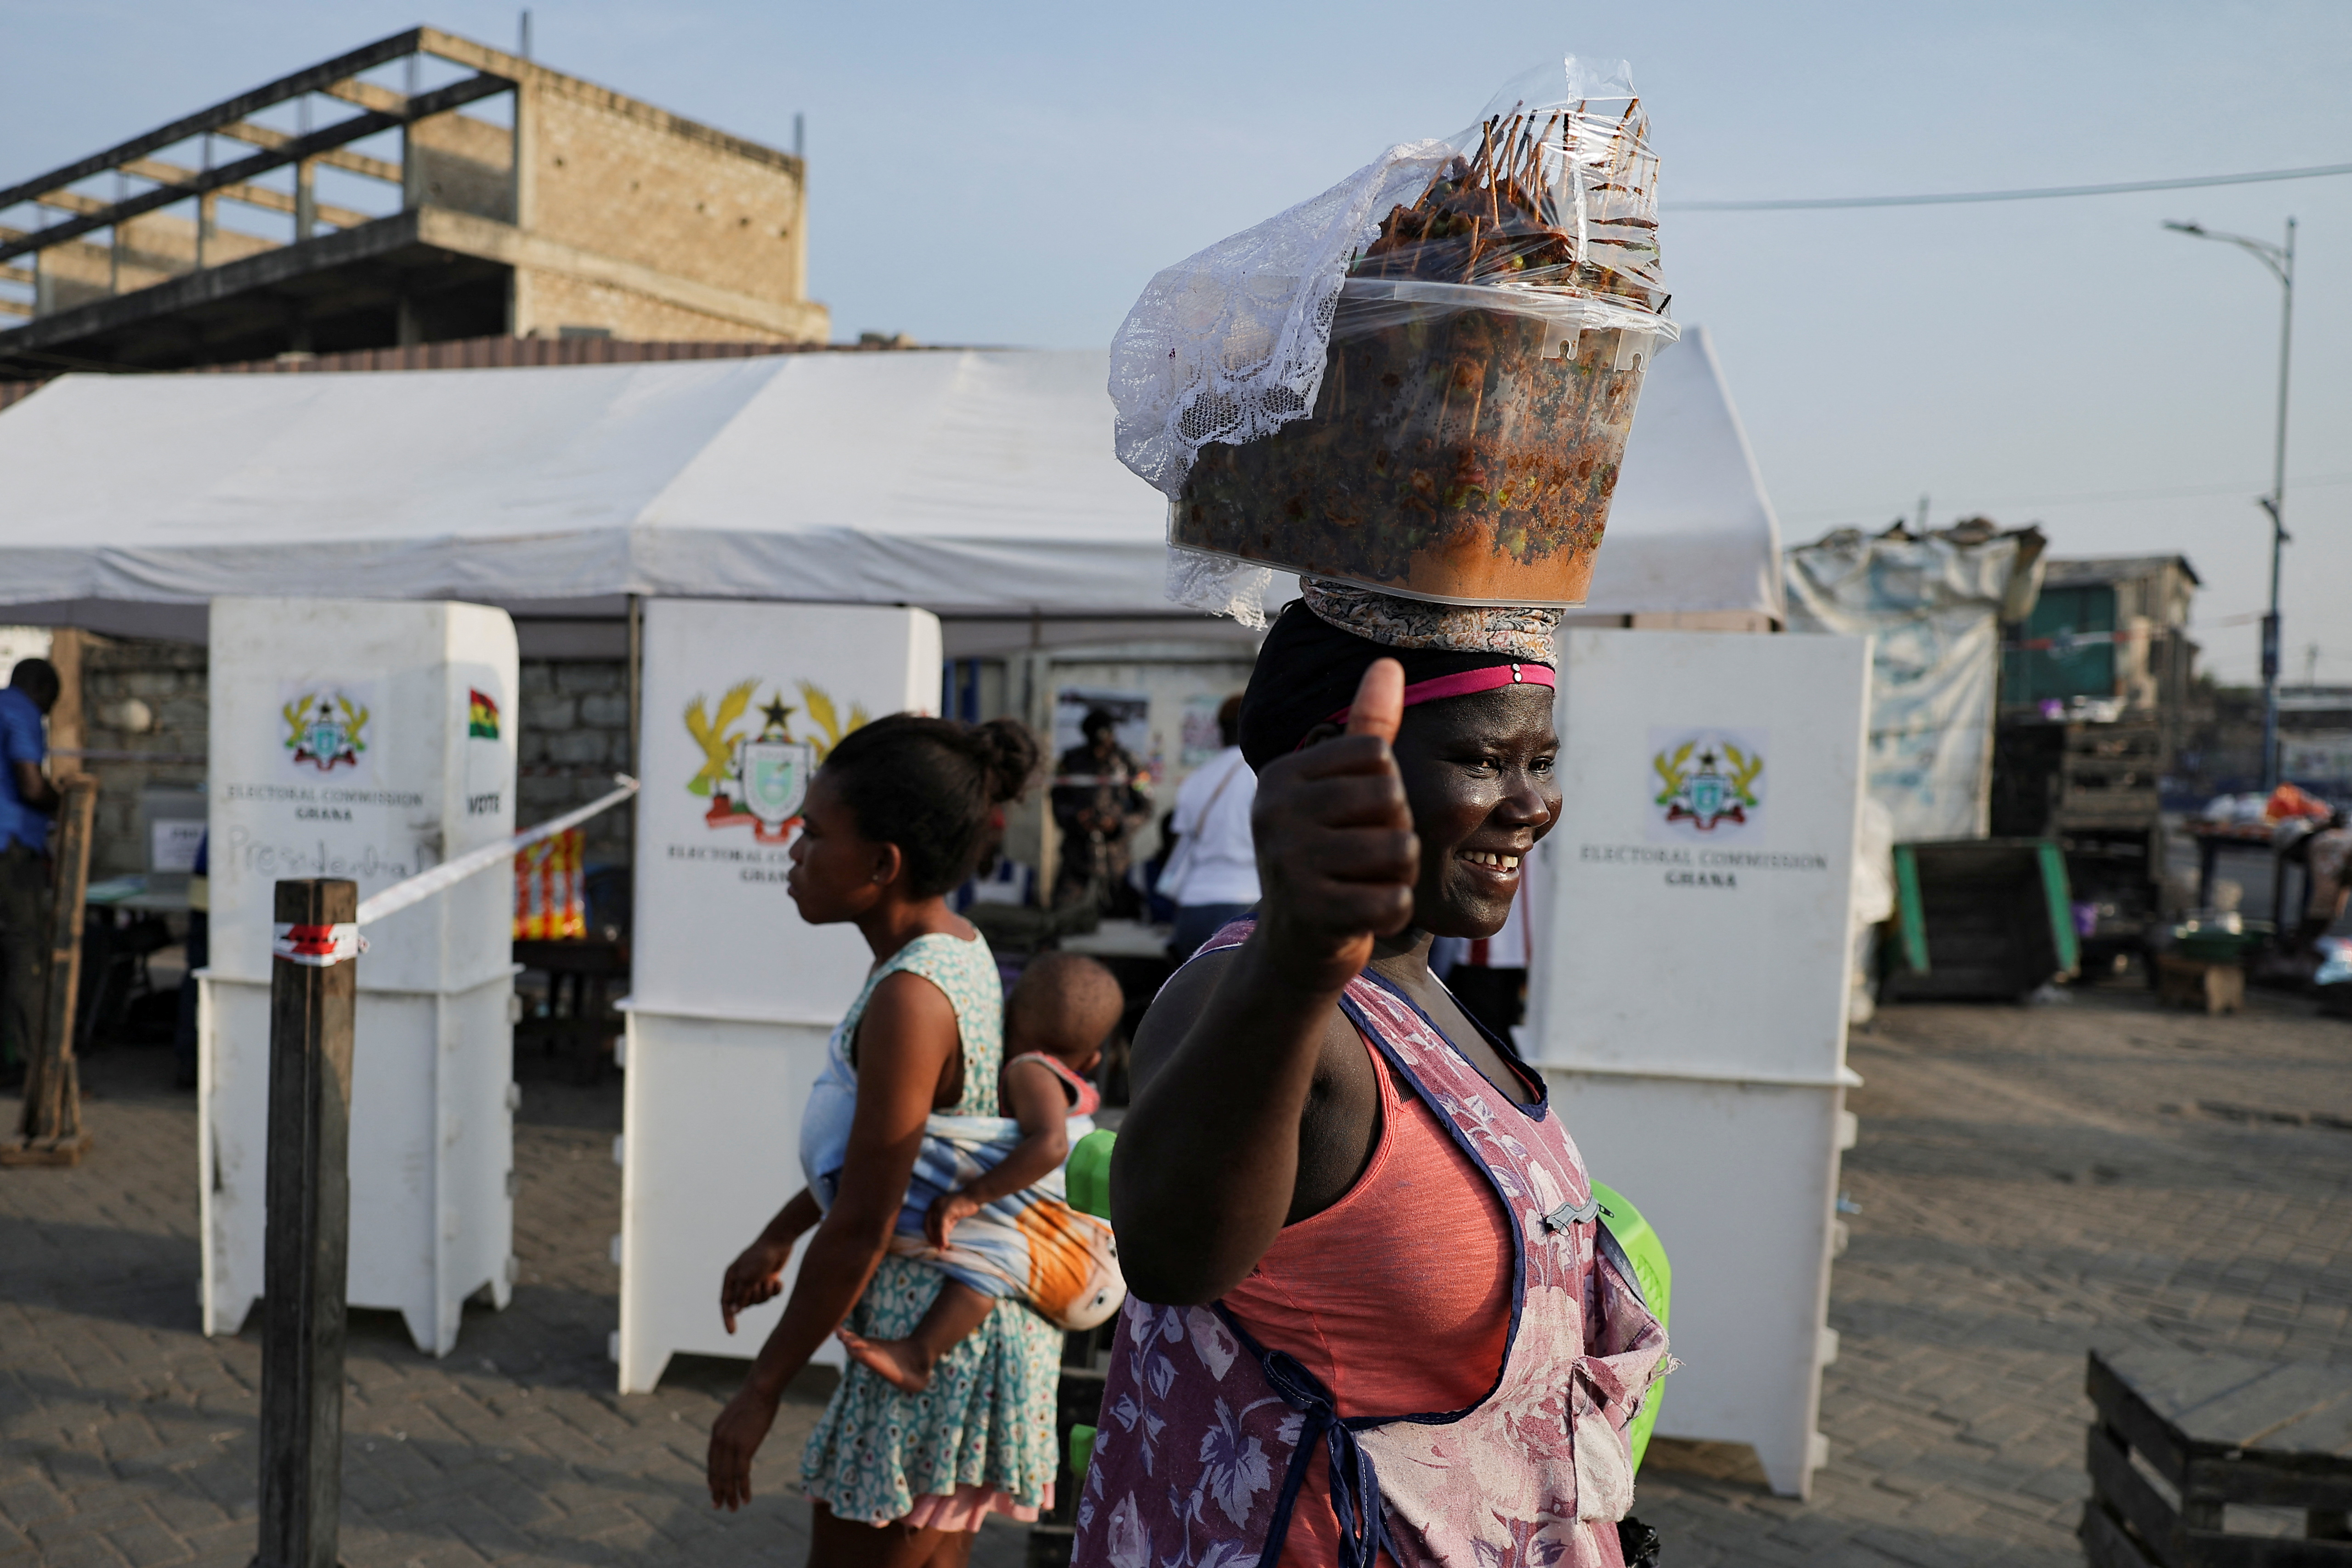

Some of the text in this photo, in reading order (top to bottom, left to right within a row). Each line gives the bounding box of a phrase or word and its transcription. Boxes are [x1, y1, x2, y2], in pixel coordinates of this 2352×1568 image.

[228, 785, 423, 807] ELECTORAL COMMISSION
[469, 794, 500, 814] VOTE
[295, 807, 353, 822] GHANA
[668, 846, 762, 862] ELECTORAL
[1580, 844, 1827, 871] ELECTORAL COMMISSION
[740, 869, 790, 882] GHAN
[1665, 872, 1737, 889] GHANA
